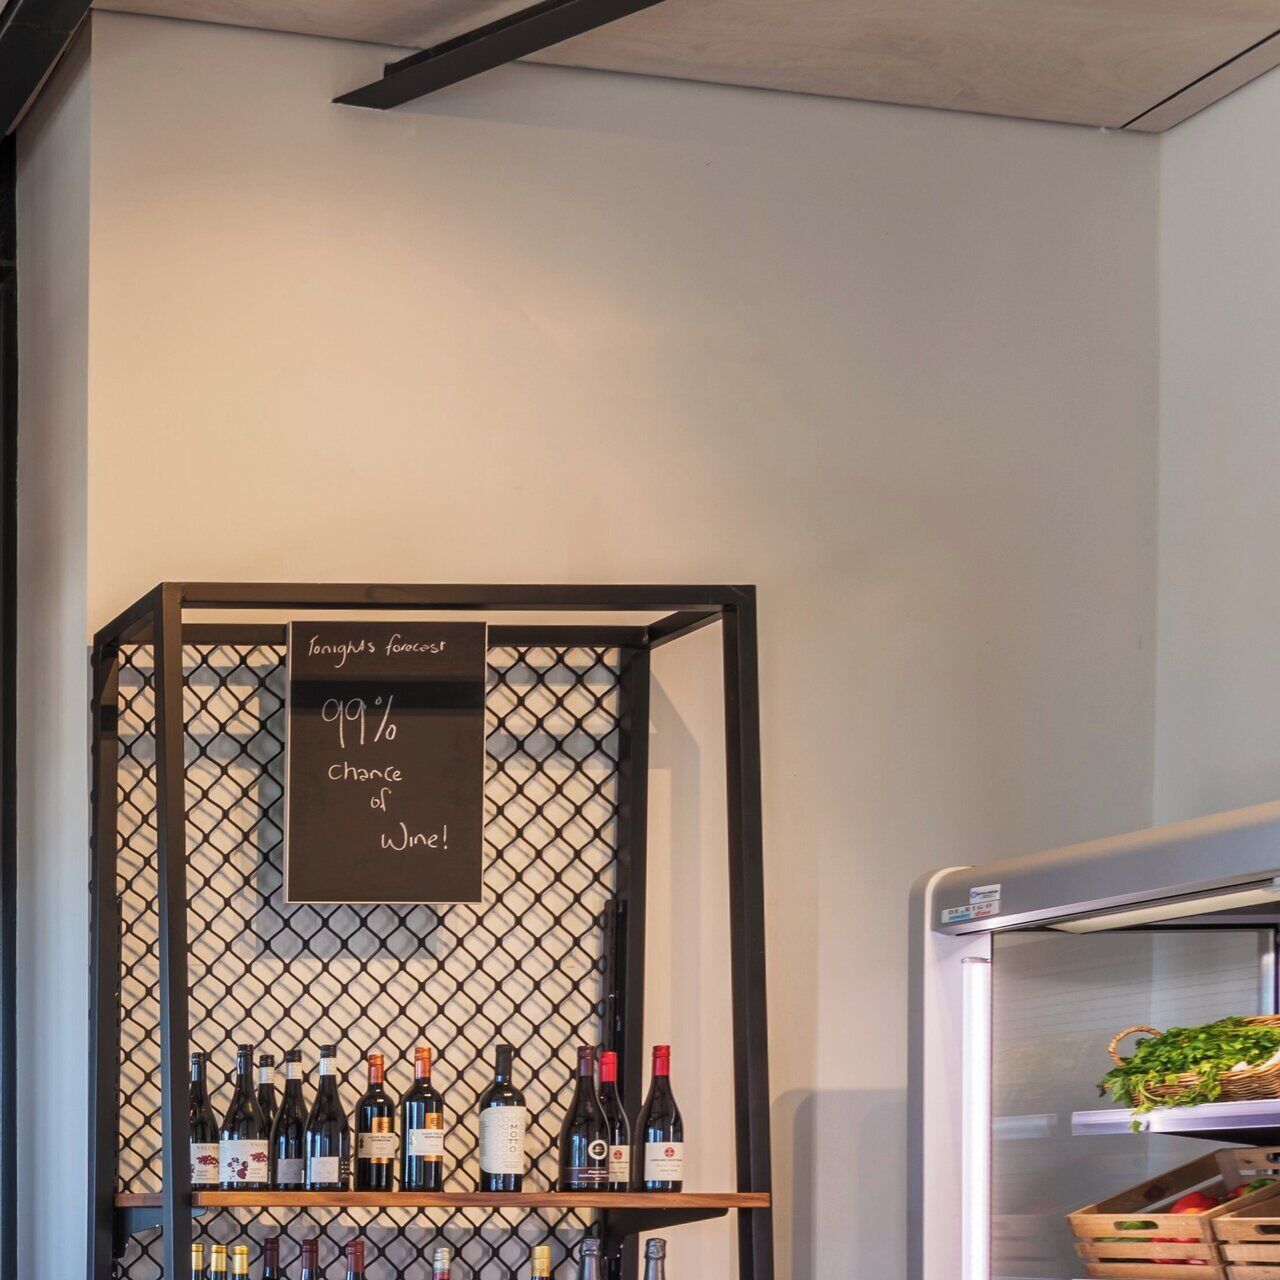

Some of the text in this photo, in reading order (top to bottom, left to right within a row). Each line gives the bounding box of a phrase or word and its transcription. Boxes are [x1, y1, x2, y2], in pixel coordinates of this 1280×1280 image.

[386, 633, 446, 656] forecast
[322, 694, 397, 748] 99%
[370, 788, 391, 811] of
